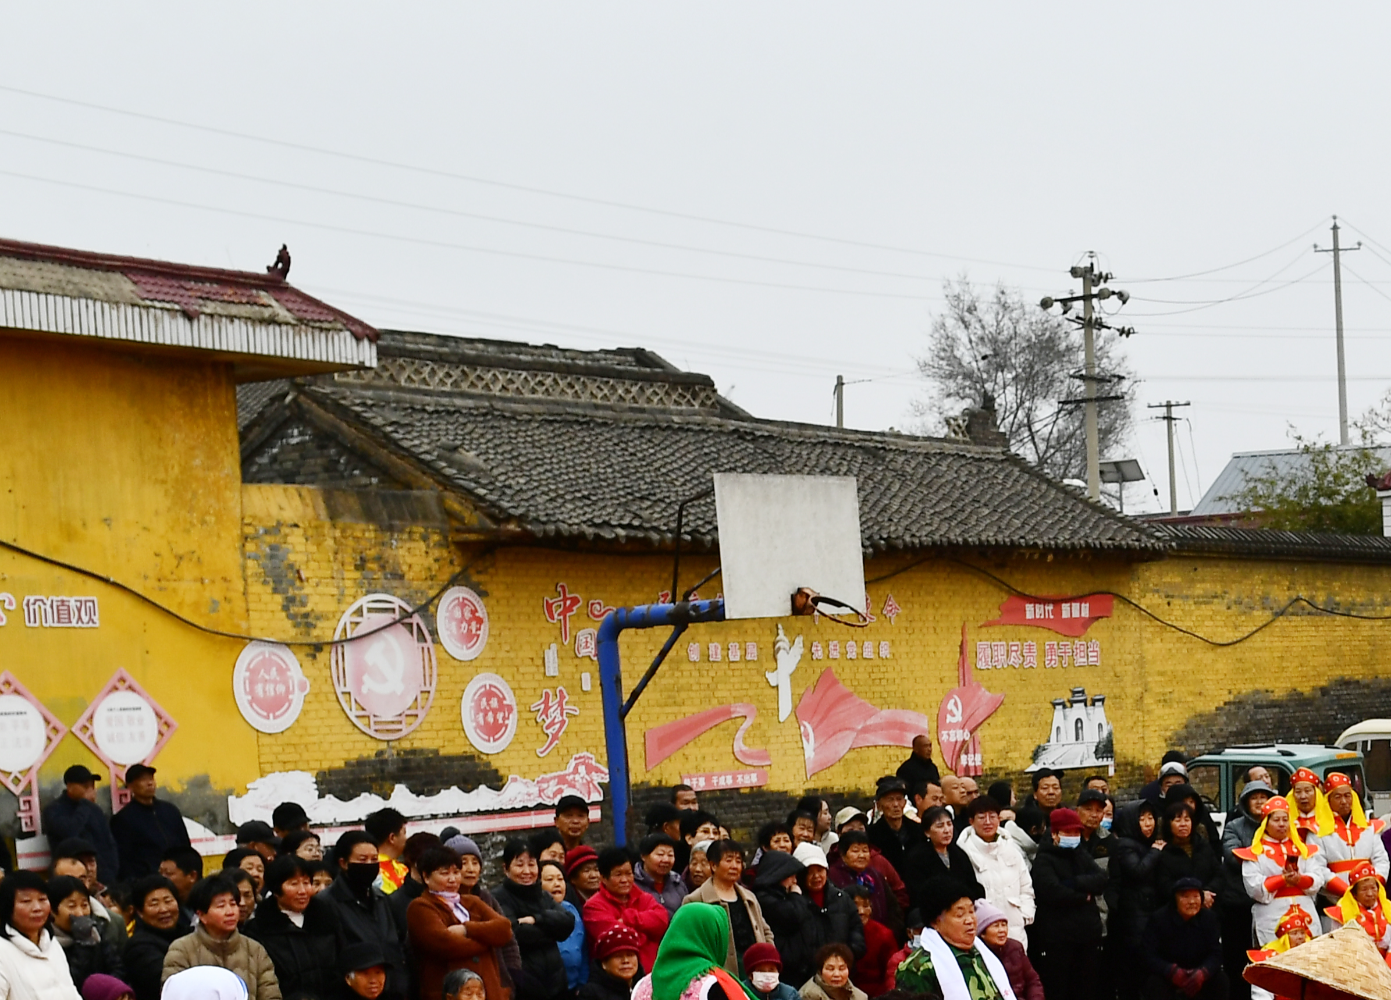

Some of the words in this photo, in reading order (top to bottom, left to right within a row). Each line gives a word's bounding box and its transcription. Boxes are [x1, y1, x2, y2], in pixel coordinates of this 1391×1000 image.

[23, 595, 100, 627] 价值观
[1025, 603, 1055, 619] 新时代
[687, 642, 758, 662] 创建基层
[811, 640, 890, 660] 先进党组织
[976, 641, 1037, 669] 履职尽责
[1045, 639, 1100, 668] 勇于担当
